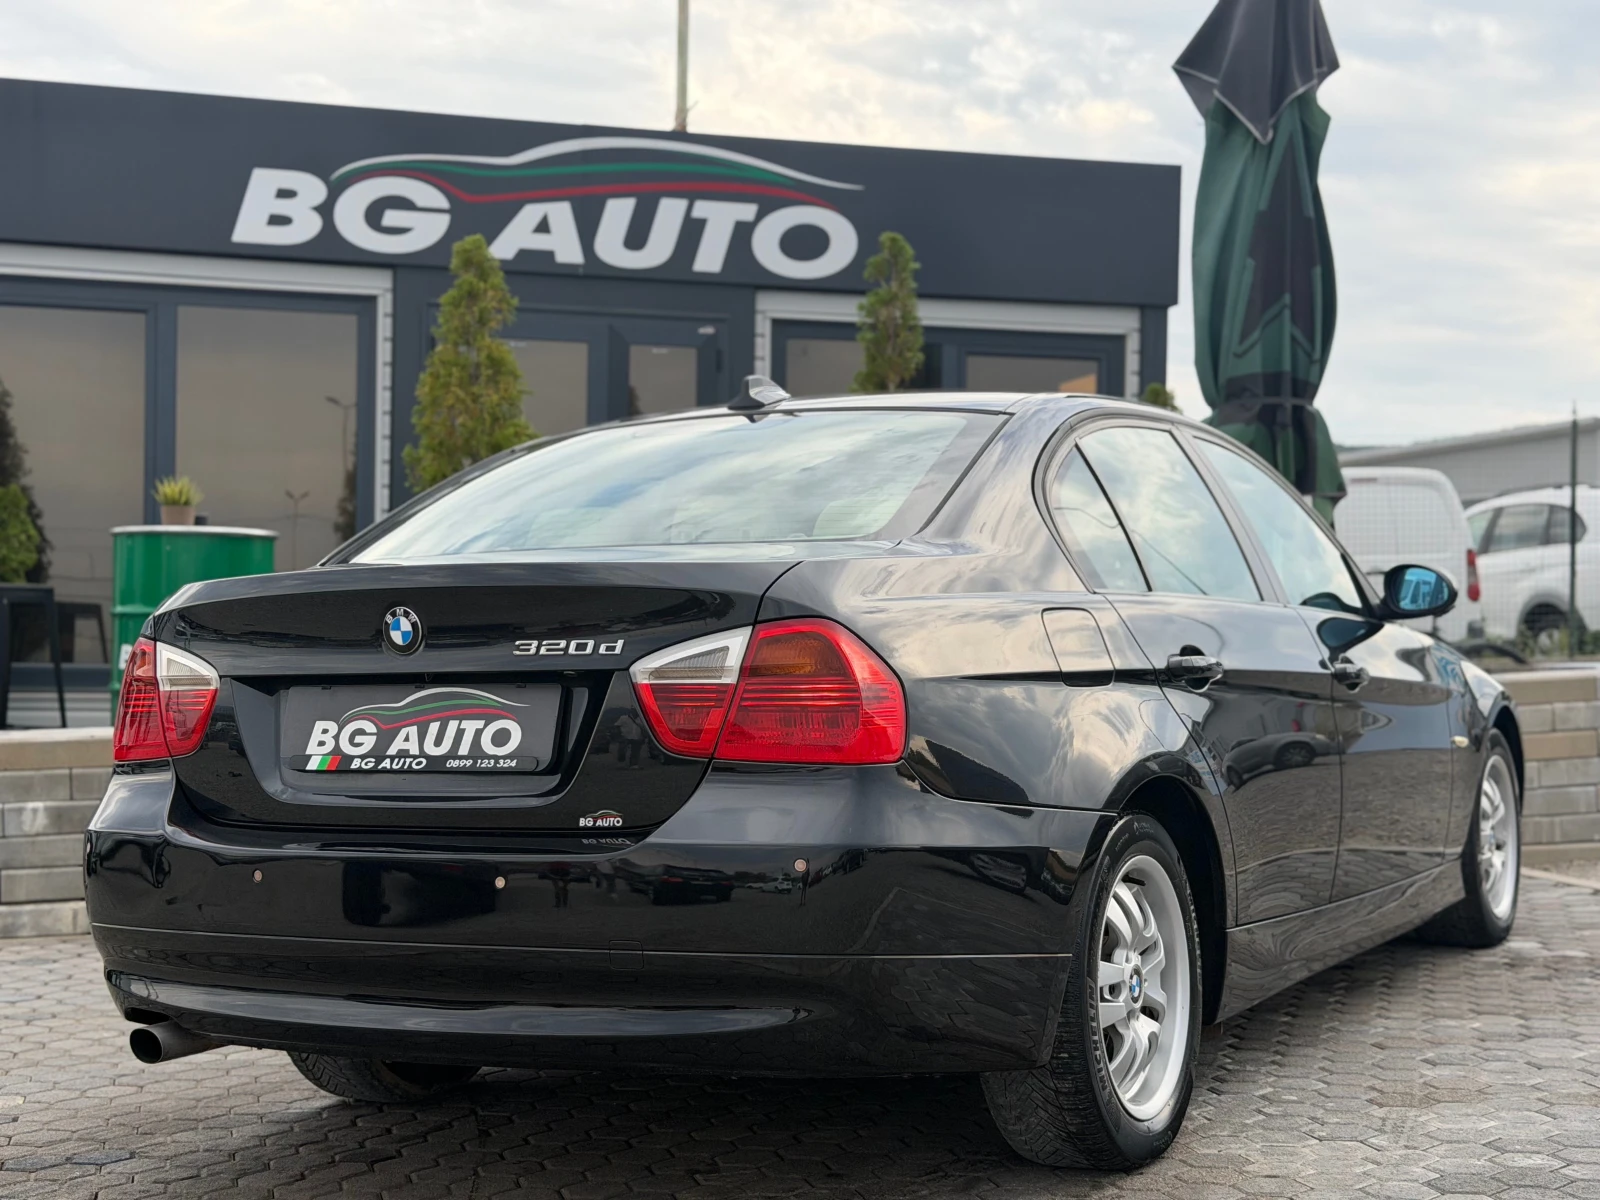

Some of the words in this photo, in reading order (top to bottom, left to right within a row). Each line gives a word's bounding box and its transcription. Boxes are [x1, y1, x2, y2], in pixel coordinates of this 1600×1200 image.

[231, 167, 452, 255] BG
[488, 196, 859, 280] AUTO
[385, 608, 417, 624] BMW
[512, 639, 625, 656] 320d
[305, 719, 378, 756] BG
[385, 719, 522, 756] AUTO
[350, 757, 376, 769] BG
[377, 757, 427, 770] AUTO
[446, 759, 473, 768] 0899
[476, 759, 494, 768] 123
[496, 759, 517, 768] 324
[579, 817, 594, 827] BG
[595, 817, 623, 827] AUTO
[1088, 983, 1108, 1092] MICHELIN
